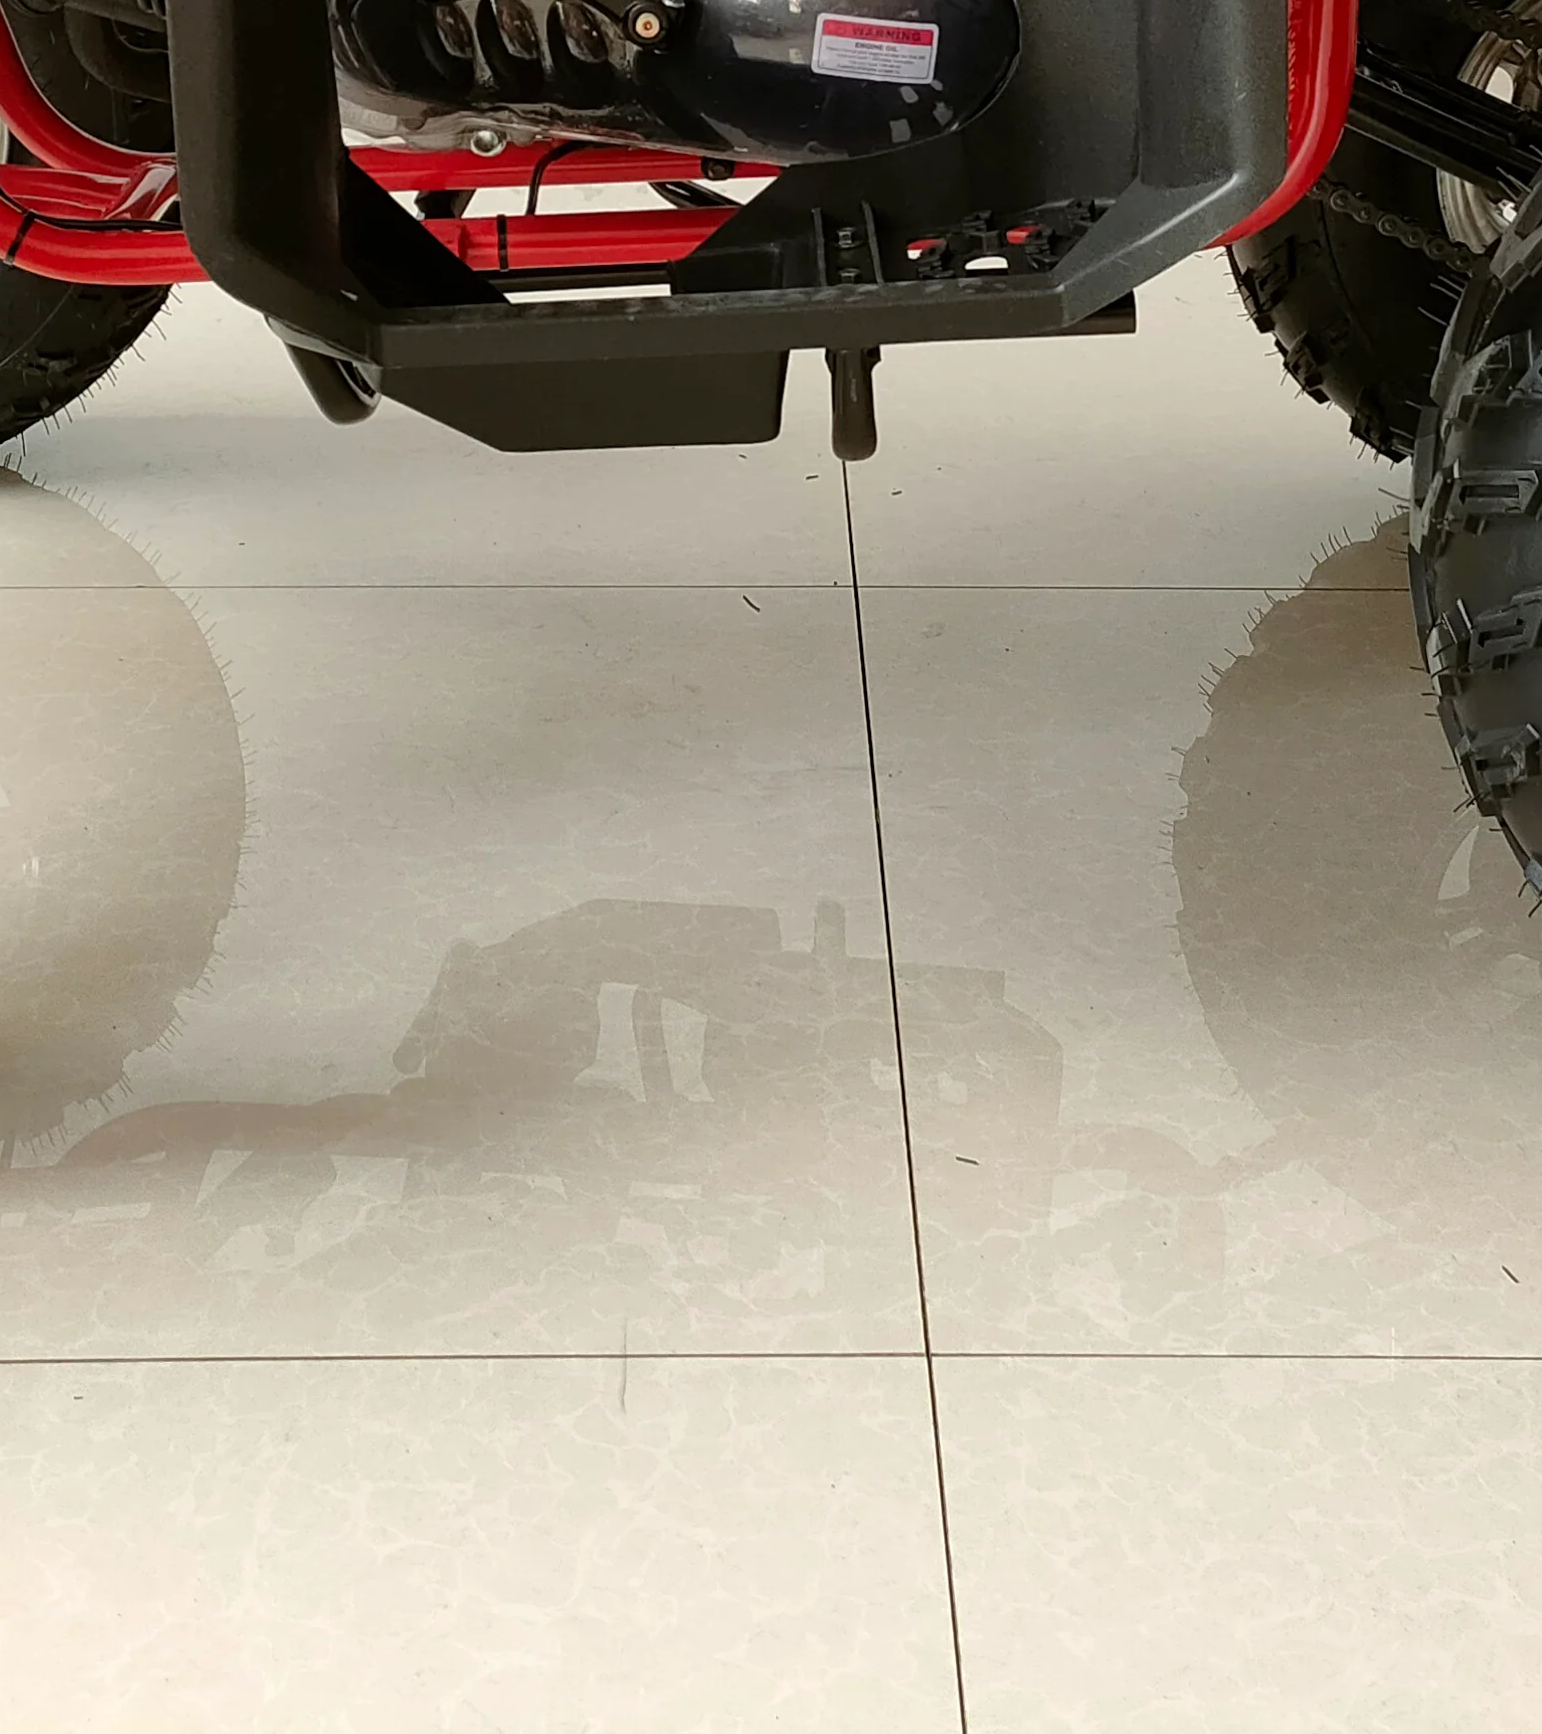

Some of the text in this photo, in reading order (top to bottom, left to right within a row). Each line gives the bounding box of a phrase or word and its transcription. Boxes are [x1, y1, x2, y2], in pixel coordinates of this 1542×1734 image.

[852, 26, 922, 42] WARNING
[854, 42, 883, 52] ENGINE
[885, 44, 899, 53] OIL
